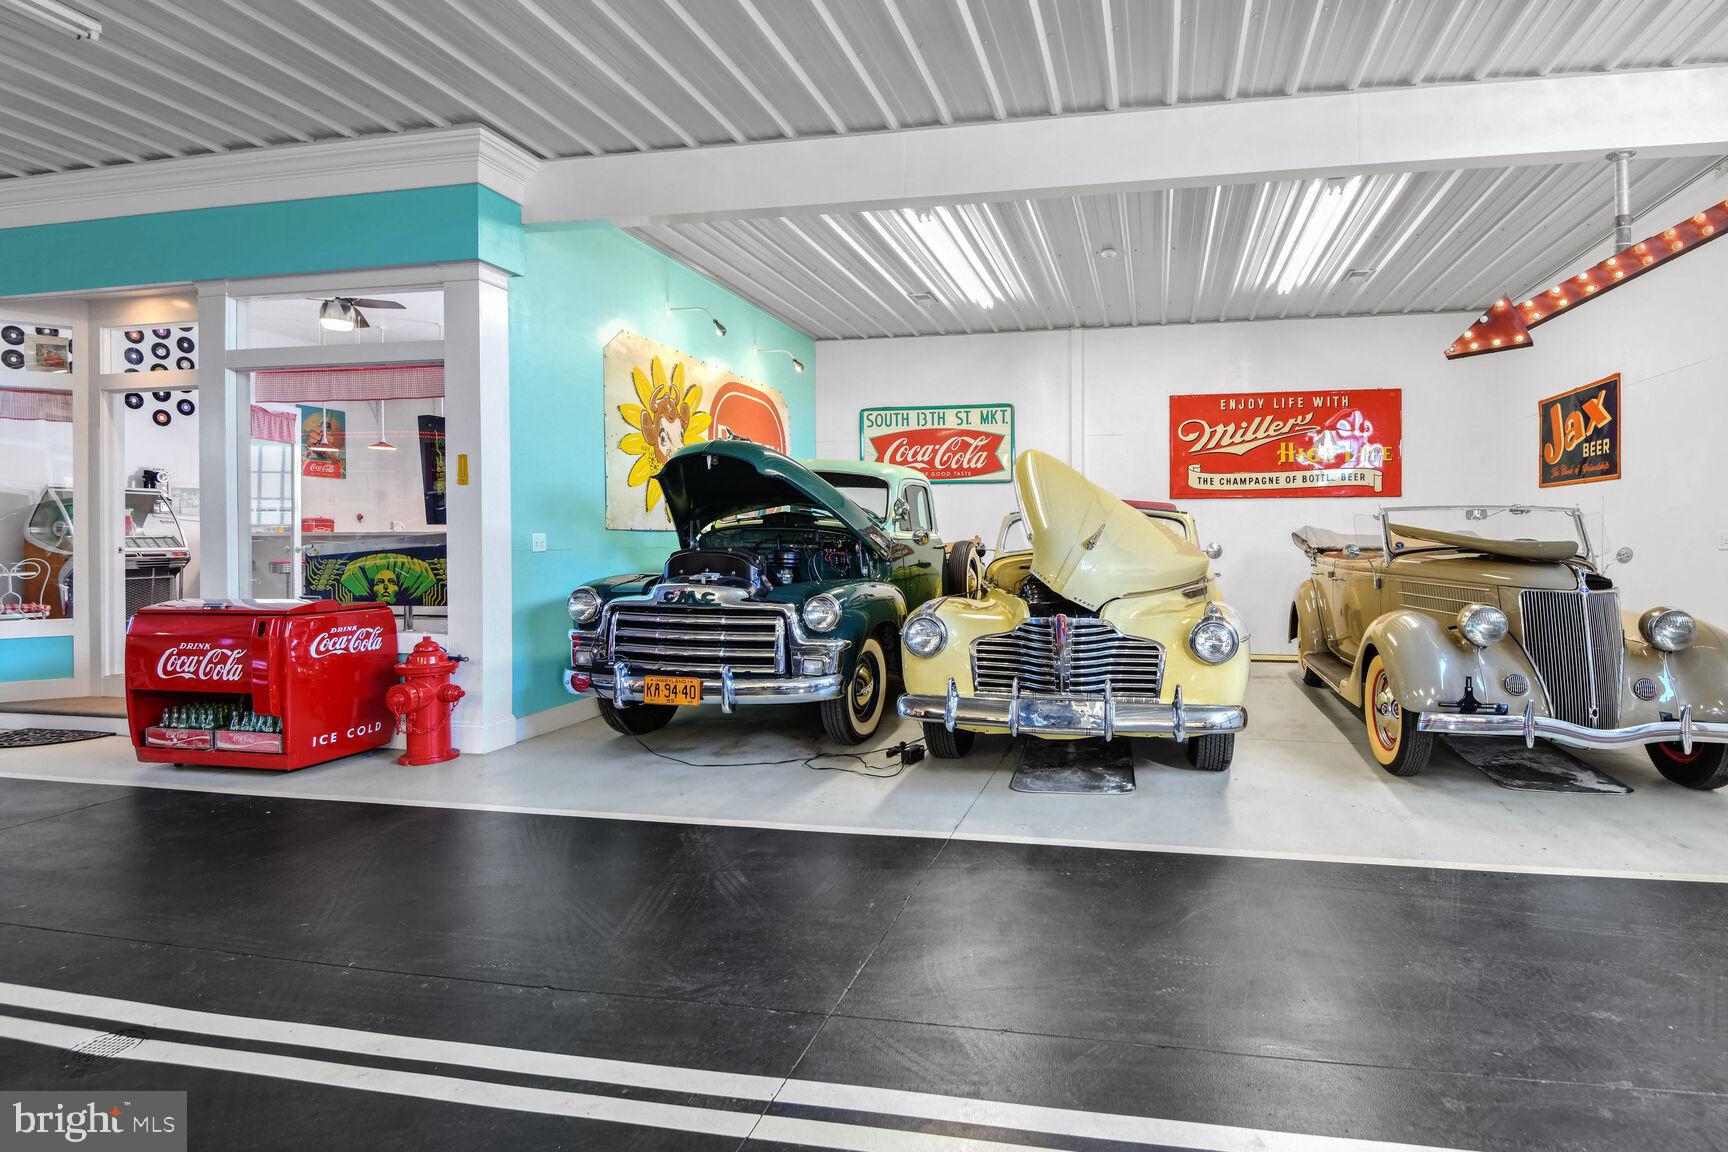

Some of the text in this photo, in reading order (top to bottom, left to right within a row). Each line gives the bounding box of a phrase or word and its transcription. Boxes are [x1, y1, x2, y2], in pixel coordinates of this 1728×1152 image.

[1220, 395, 1350, 410] ENJOY LIFE WITH
[866, 409, 1009, 428] SOUTH 13TH ST. MKT.
[1544, 389, 1613, 465] Jax
[1178, 411, 1321, 456] Miller
[884, 435, 992, 469] Coca-Cola
[1582, 438, 1610, 457] BEER
[1197, 472, 1366, 486] THE CHAMPAGNE OF BOTTL BEER
[330, 625, 358, 634] DRINK
[178, 642, 212, 650] DRINK
[310, 626, 384, 658] Coca-Cola
[157, 647, 247, 680] Coca-Cola
[312, 721, 382, 748] ICE COLD
